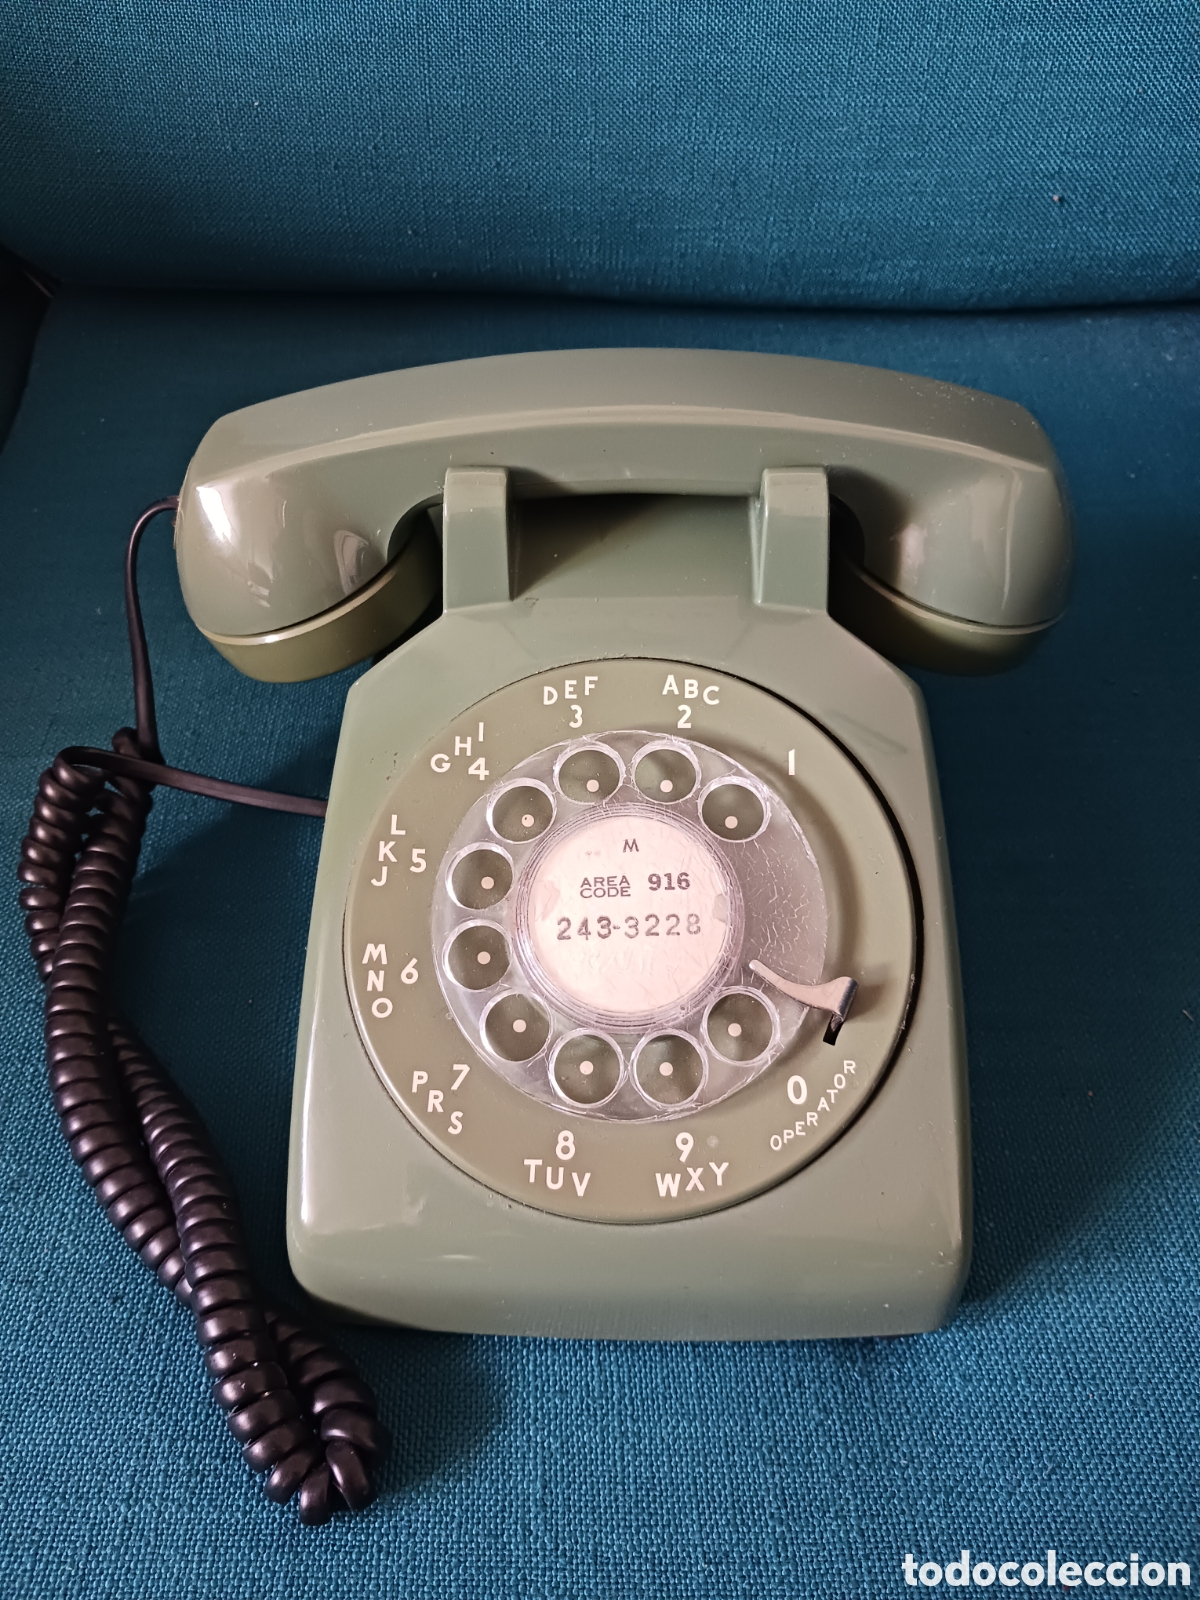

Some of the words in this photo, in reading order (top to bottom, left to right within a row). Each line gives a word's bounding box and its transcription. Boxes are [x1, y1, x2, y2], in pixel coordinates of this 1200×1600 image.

[543, 676, 598, 705] DEF
[662, 674, 720, 705] ABC
[569, 704, 583, 728] 3
[677, 705, 692, 729] 2
[468, 757, 489, 780] 4
[788, 748, 796, 776] 1
[622, 838, 639, 853] M
[409, 848, 427, 873] 5
[579, 887, 631, 899] CODE
[580, 875, 630, 888] AREA
[647, 872, 691, 891] 916
[556, 913, 701, 940] 243-3228
[400, 957, 419, 984] 6
[450, 1064, 470, 1090] 7
[769, 1060, 856, 1151] OPERATOR
[555, 1130, 576, 1160] 8
[675, 1132, 694, 1163] 9
[524, 1159, 591, 1197] TUV
[655, 1162, 729, 1197] WXY
